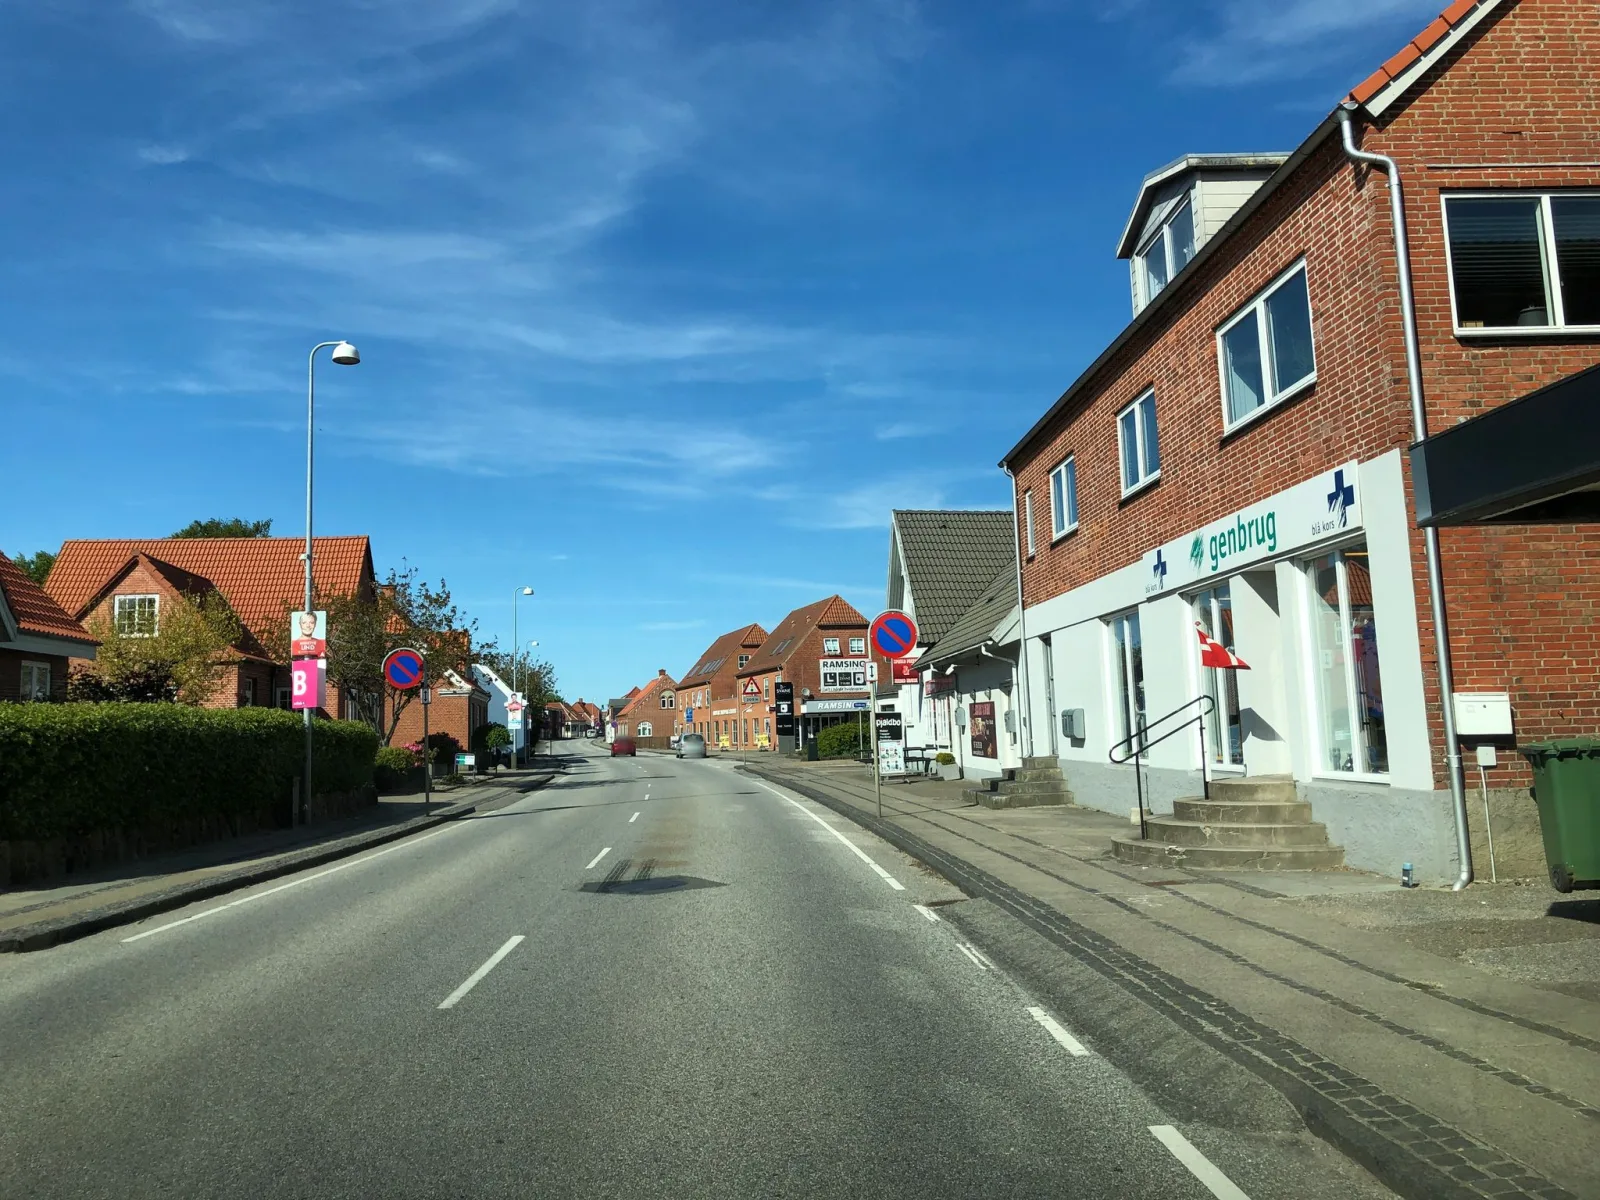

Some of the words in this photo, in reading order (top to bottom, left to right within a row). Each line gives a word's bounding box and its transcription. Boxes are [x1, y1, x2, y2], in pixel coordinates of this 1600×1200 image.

[1311, 521, 1321, 536] blå
[1322, 520, 1335, 532] kors
[1209, 511, 1276, 571] genbrug
[293, 670, 307, 696] B
[818, 701, 861, 710] RAMSIN
